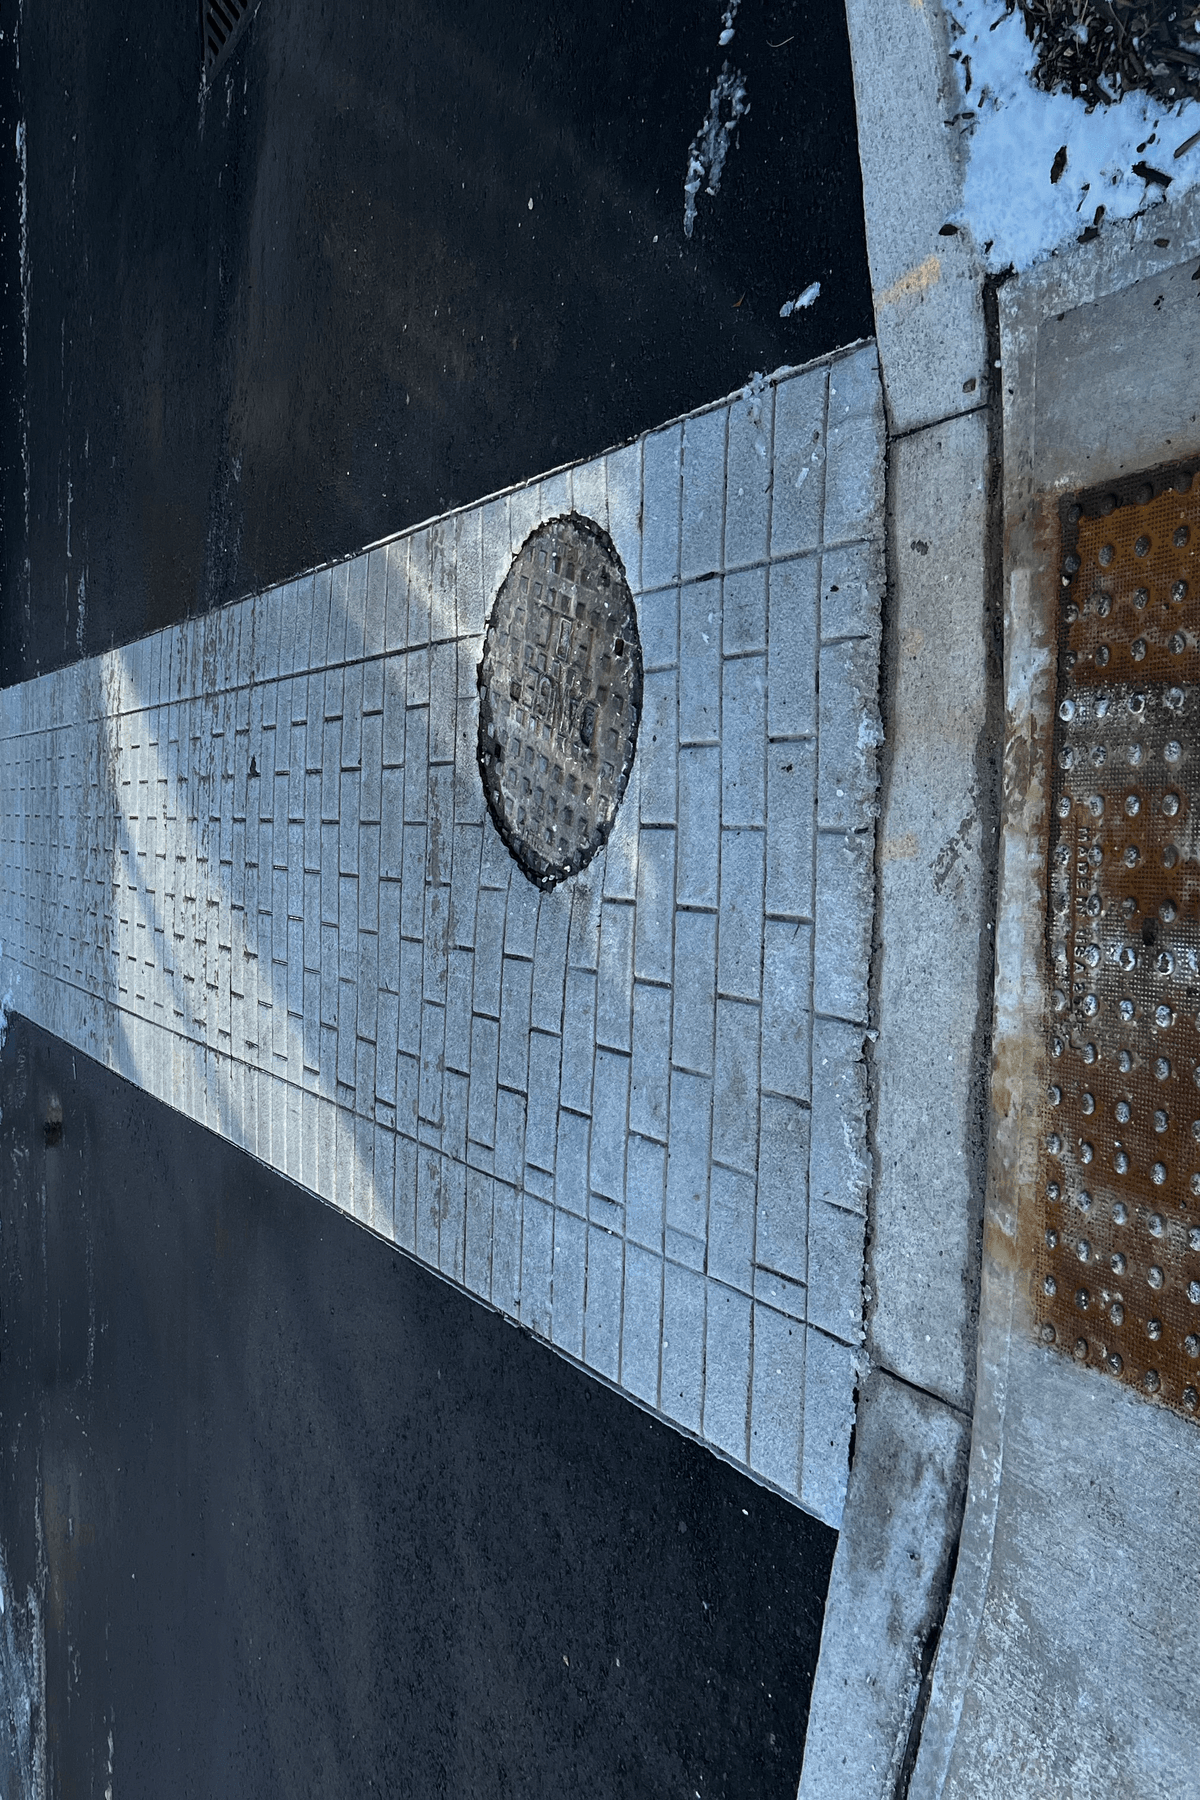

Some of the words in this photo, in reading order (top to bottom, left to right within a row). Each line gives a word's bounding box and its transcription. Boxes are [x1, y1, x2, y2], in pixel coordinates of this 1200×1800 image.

[1077, 827, 1091, 889] MADE
[1075, 896, 1088, 916] IN
[1073, 930, 1086, 974] USA
